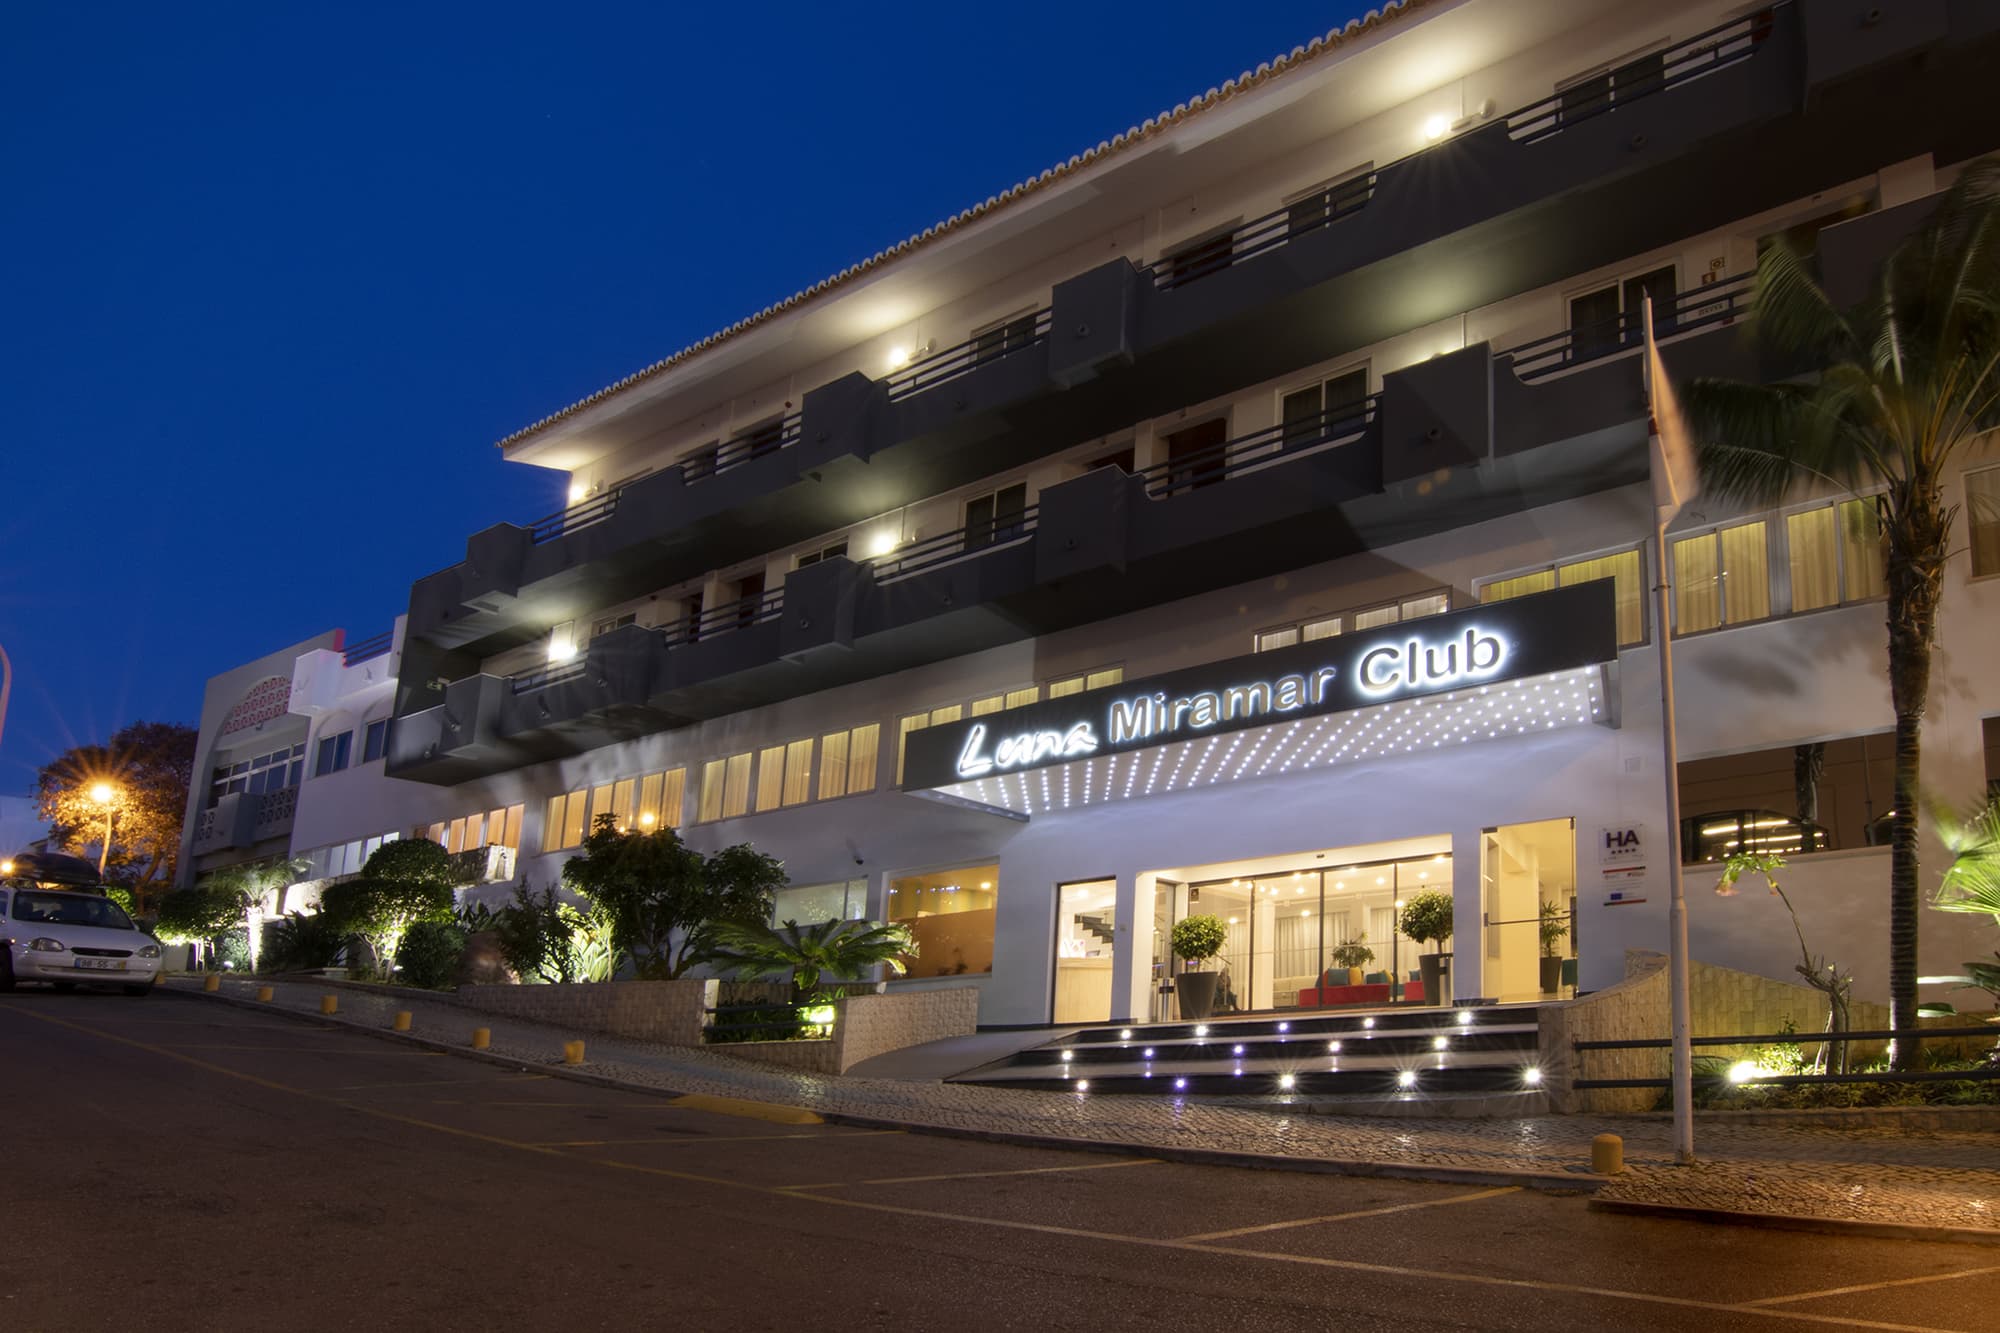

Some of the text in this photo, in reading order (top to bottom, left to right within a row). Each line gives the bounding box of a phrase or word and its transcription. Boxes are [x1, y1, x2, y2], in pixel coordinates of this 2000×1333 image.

[959, 627, 1503, 776] Luna Miramar Club
[1606, 829, 1640, 848] HA
